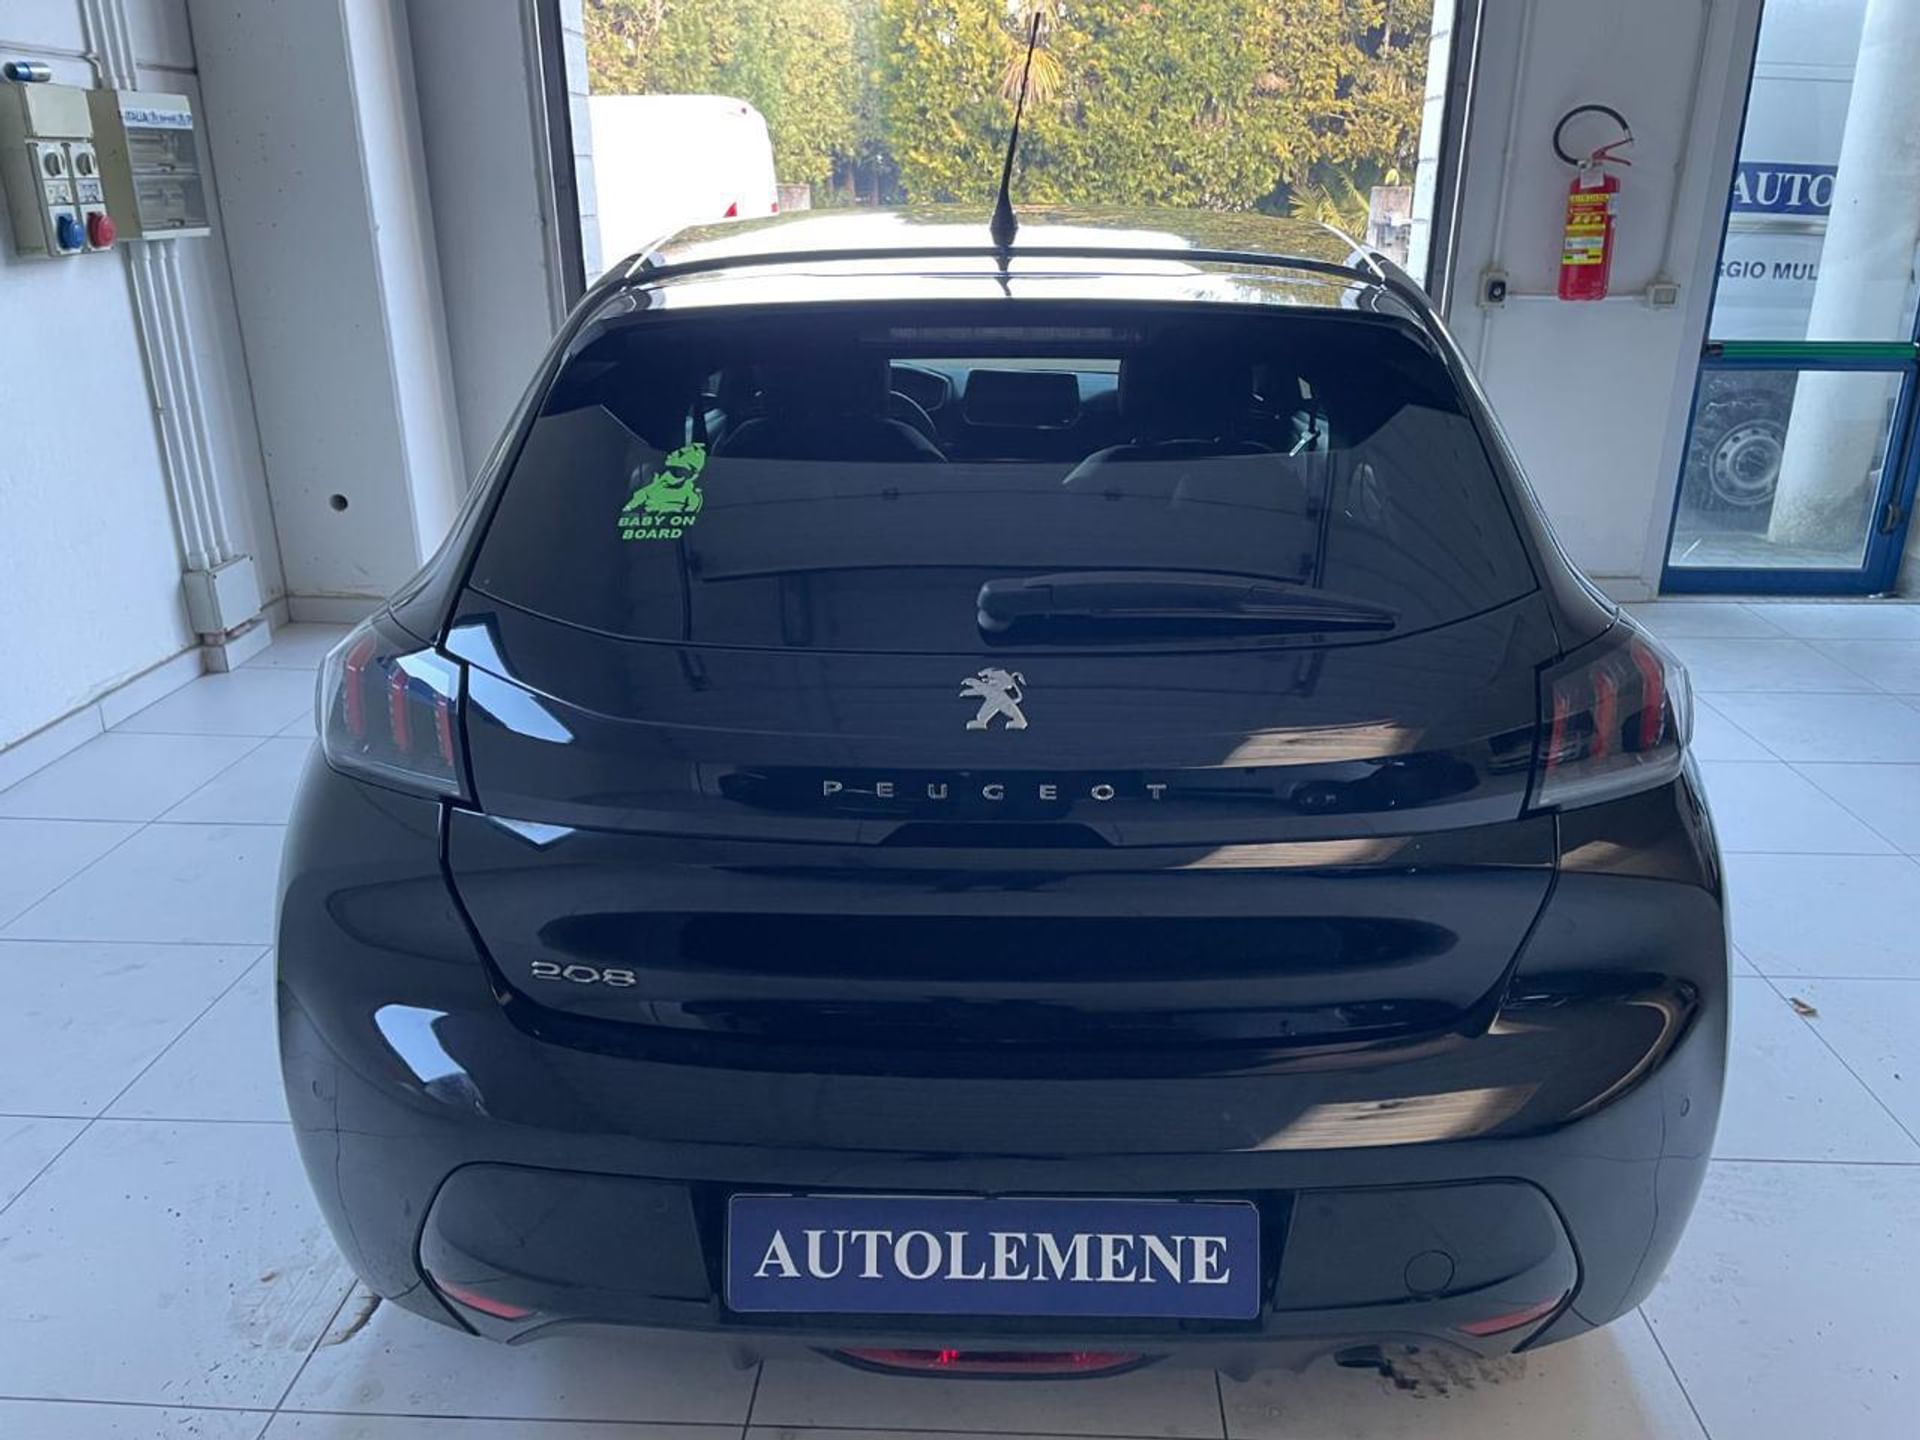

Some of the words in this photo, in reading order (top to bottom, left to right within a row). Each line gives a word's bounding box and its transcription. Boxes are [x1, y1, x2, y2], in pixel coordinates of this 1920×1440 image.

[1733, 171, 1837, 207] AUTO
[1772, 262, 1818, 280] MUL
[618, 515, 666, 527] BABY
[670, 515, 696, 526] ON
[622, 528, 683, 540] BOARD
[823, 780, 1167, 801] PEUGEOT
[531, 960, 637, 987] 208
[753, 1229, 1231, 1285] AUTOLEMENE
